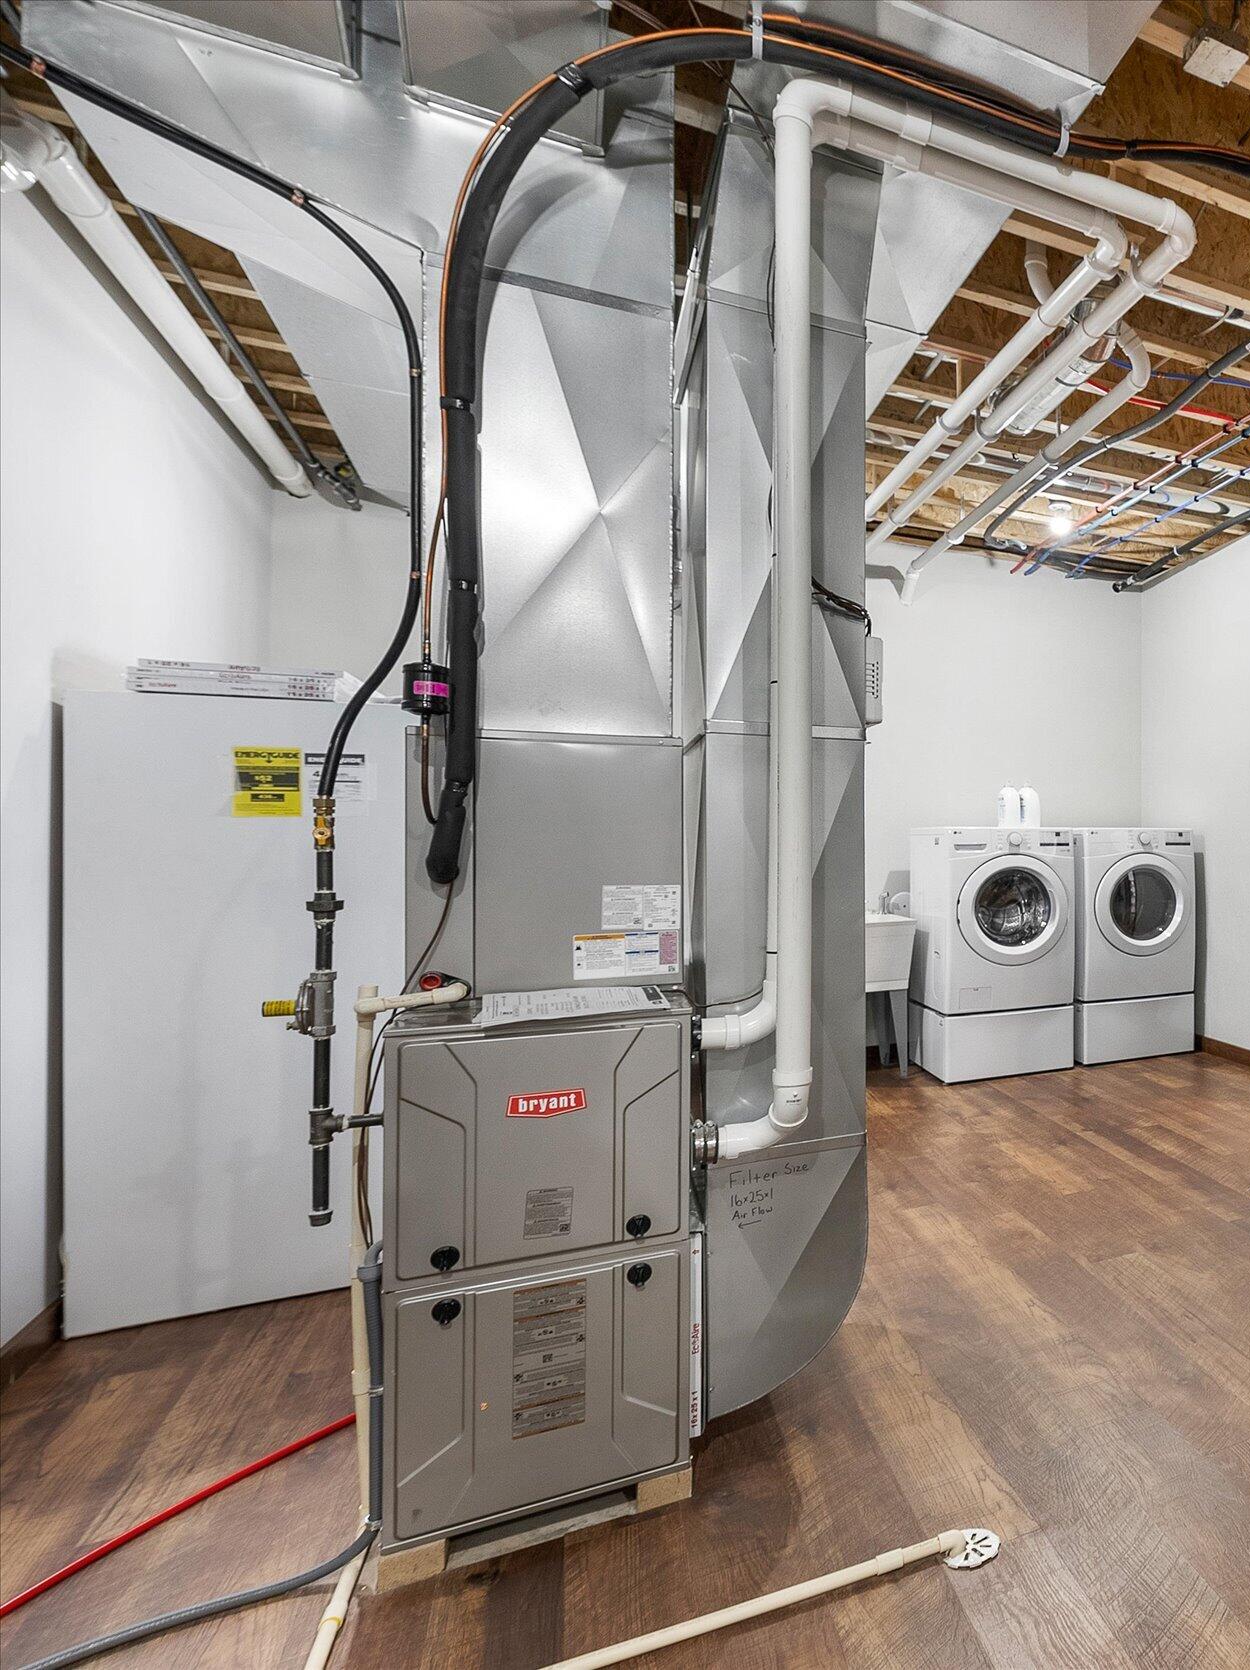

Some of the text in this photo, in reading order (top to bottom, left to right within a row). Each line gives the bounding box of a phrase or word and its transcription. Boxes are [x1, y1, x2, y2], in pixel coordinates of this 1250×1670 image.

[518, 1093, 577, 1113] bryant
[729, 1162, 810, 1188] Filter Size
[731, 1206, 773, 1221] Air Flow
